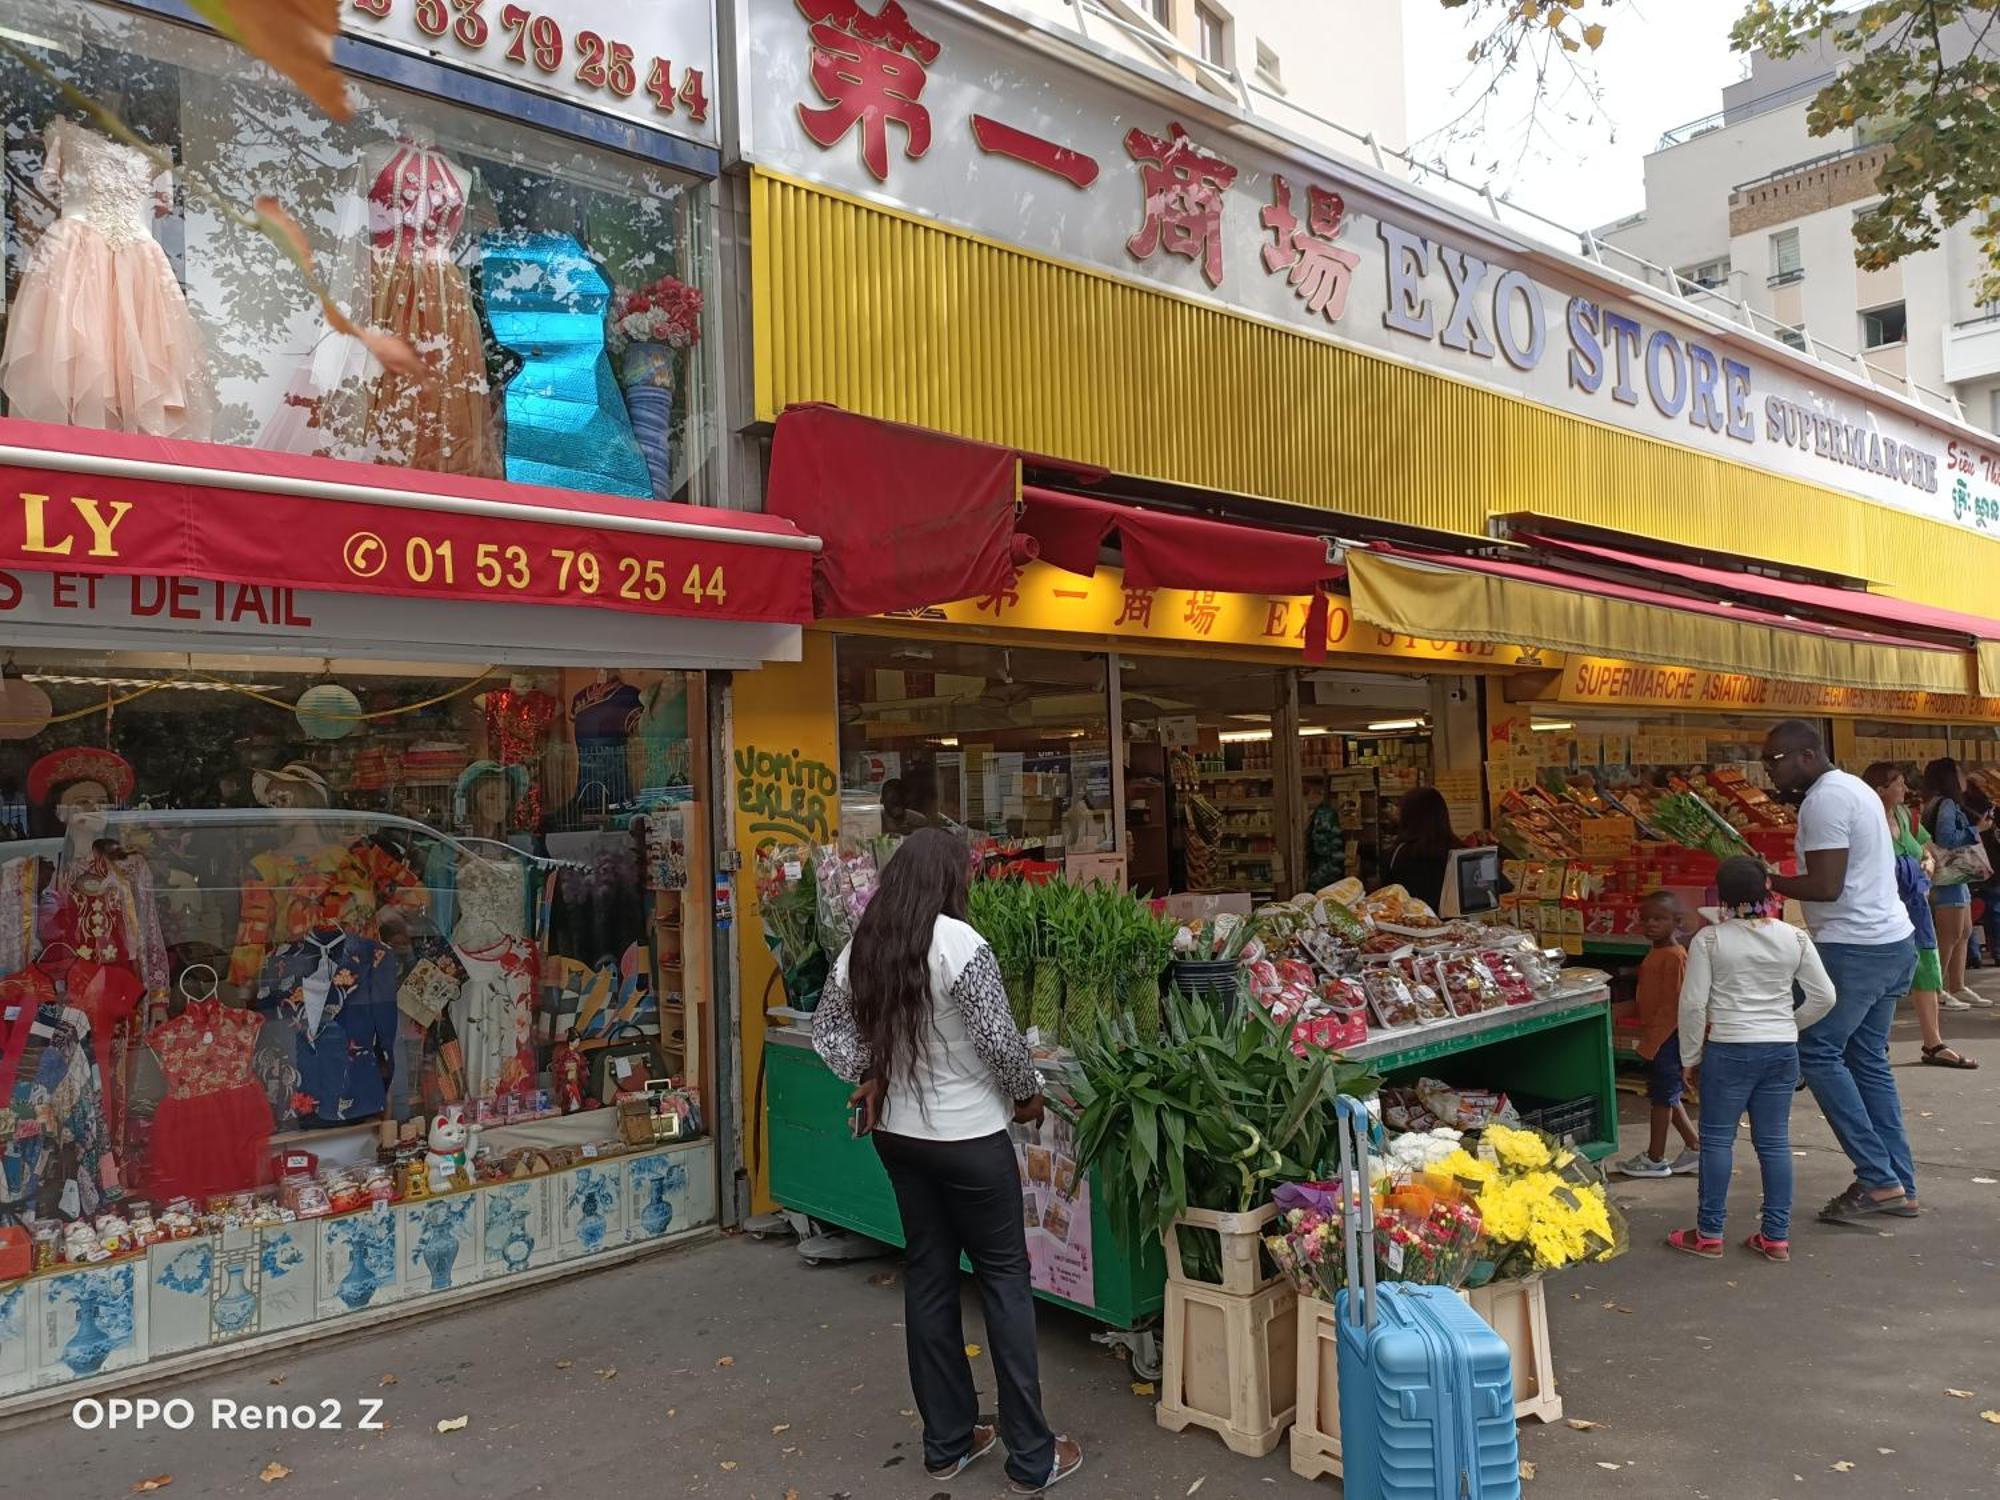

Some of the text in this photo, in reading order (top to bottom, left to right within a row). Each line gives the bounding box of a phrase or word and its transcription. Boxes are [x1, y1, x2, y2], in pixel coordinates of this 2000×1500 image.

[416, 0, 708, 122] 53 79 25 44
[1377, 221, 1938, 494] EXO STORE SUPERMARCHE
[19, 493, 133, 557] LY
[53, 572, 104, 609] ET
[405, 537, 727, 605] 01 53 79 25 44
[1576, 664, 1697, 700] SUPERMARCHE
[1700, 674, 1768, 704] ASIATIQUE
